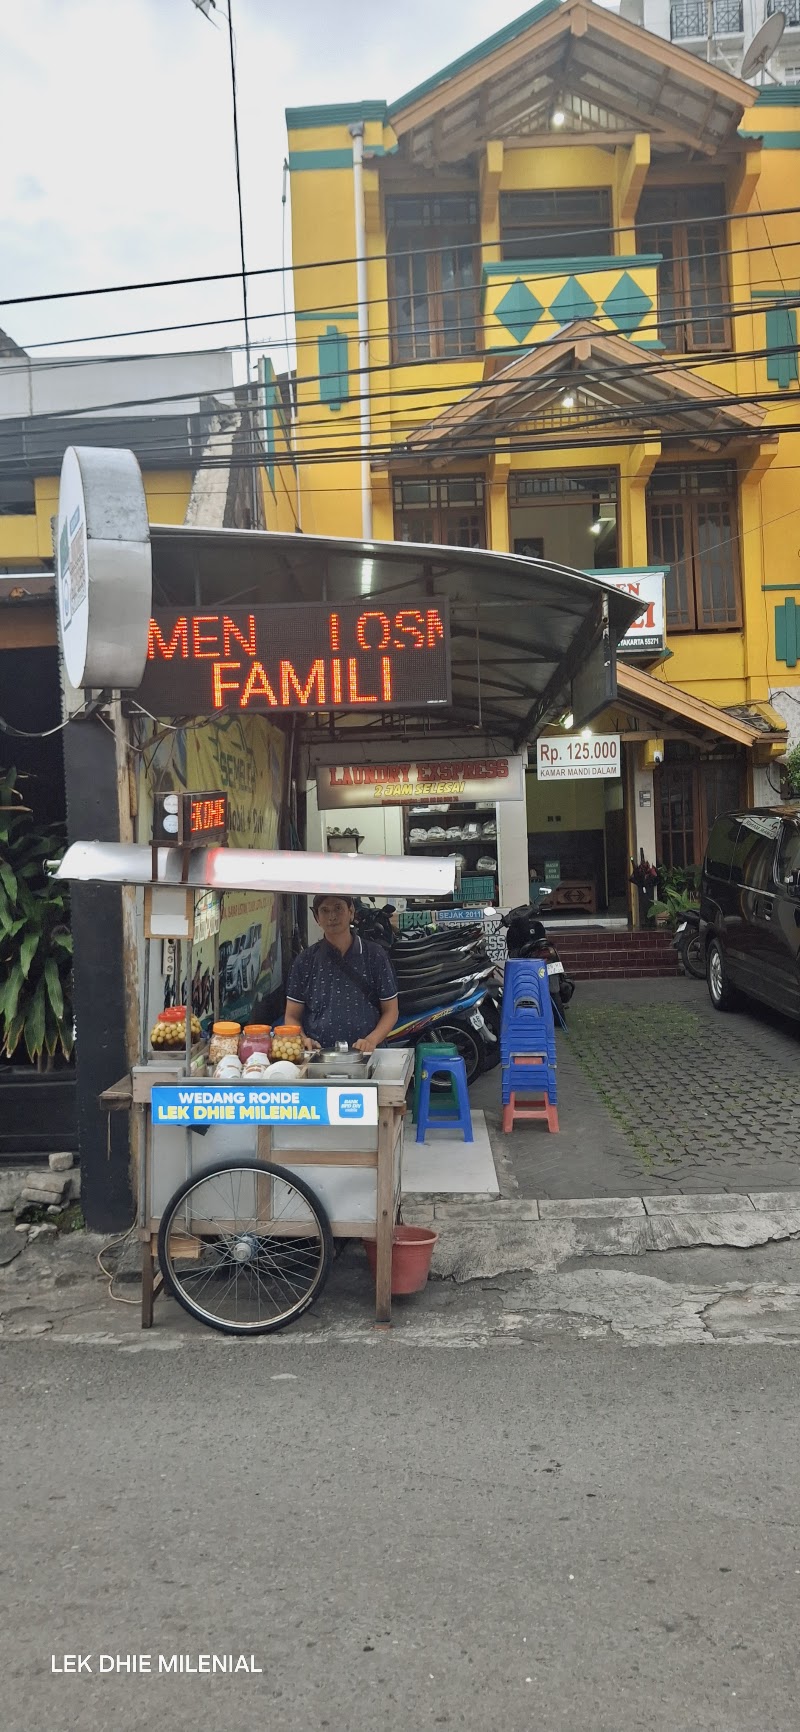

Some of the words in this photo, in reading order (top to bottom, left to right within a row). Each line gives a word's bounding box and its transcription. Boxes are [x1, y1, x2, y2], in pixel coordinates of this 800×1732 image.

[147, 614, 257, 659] MEN
[618, 638, 645, 647] YAKARTA
[212, 656, 392, 708] FAMILI
[540, 743, 562, 765] Rp.
[566, 741, 617, 760] 125.000
[329, 763, 411, 786] LAUNDRY
[416, 759, 509, 782] EXSPRESS
[540, 768, 566, 777] KAMAR
[567, 767, 591, 776] MANDI
[592, 766, 617, 775] DALAM
[374, 784, 383, 798] 2
[384, 783, 414, 797] JAM
[415, 781, 466, 795] SELESAI
[439, 911, 464, 919] SEJAK
[465, 910, 482, 918] 2011
[178, 1092, 245, 1105] WEDANG
[251, 1092, 300, 1104] RONDE
[158, 1106, 190, 1121] LEK
[194, 1106, 236, 1120] DHIE
[239, 1105, 321, 1120] MILENIAL
